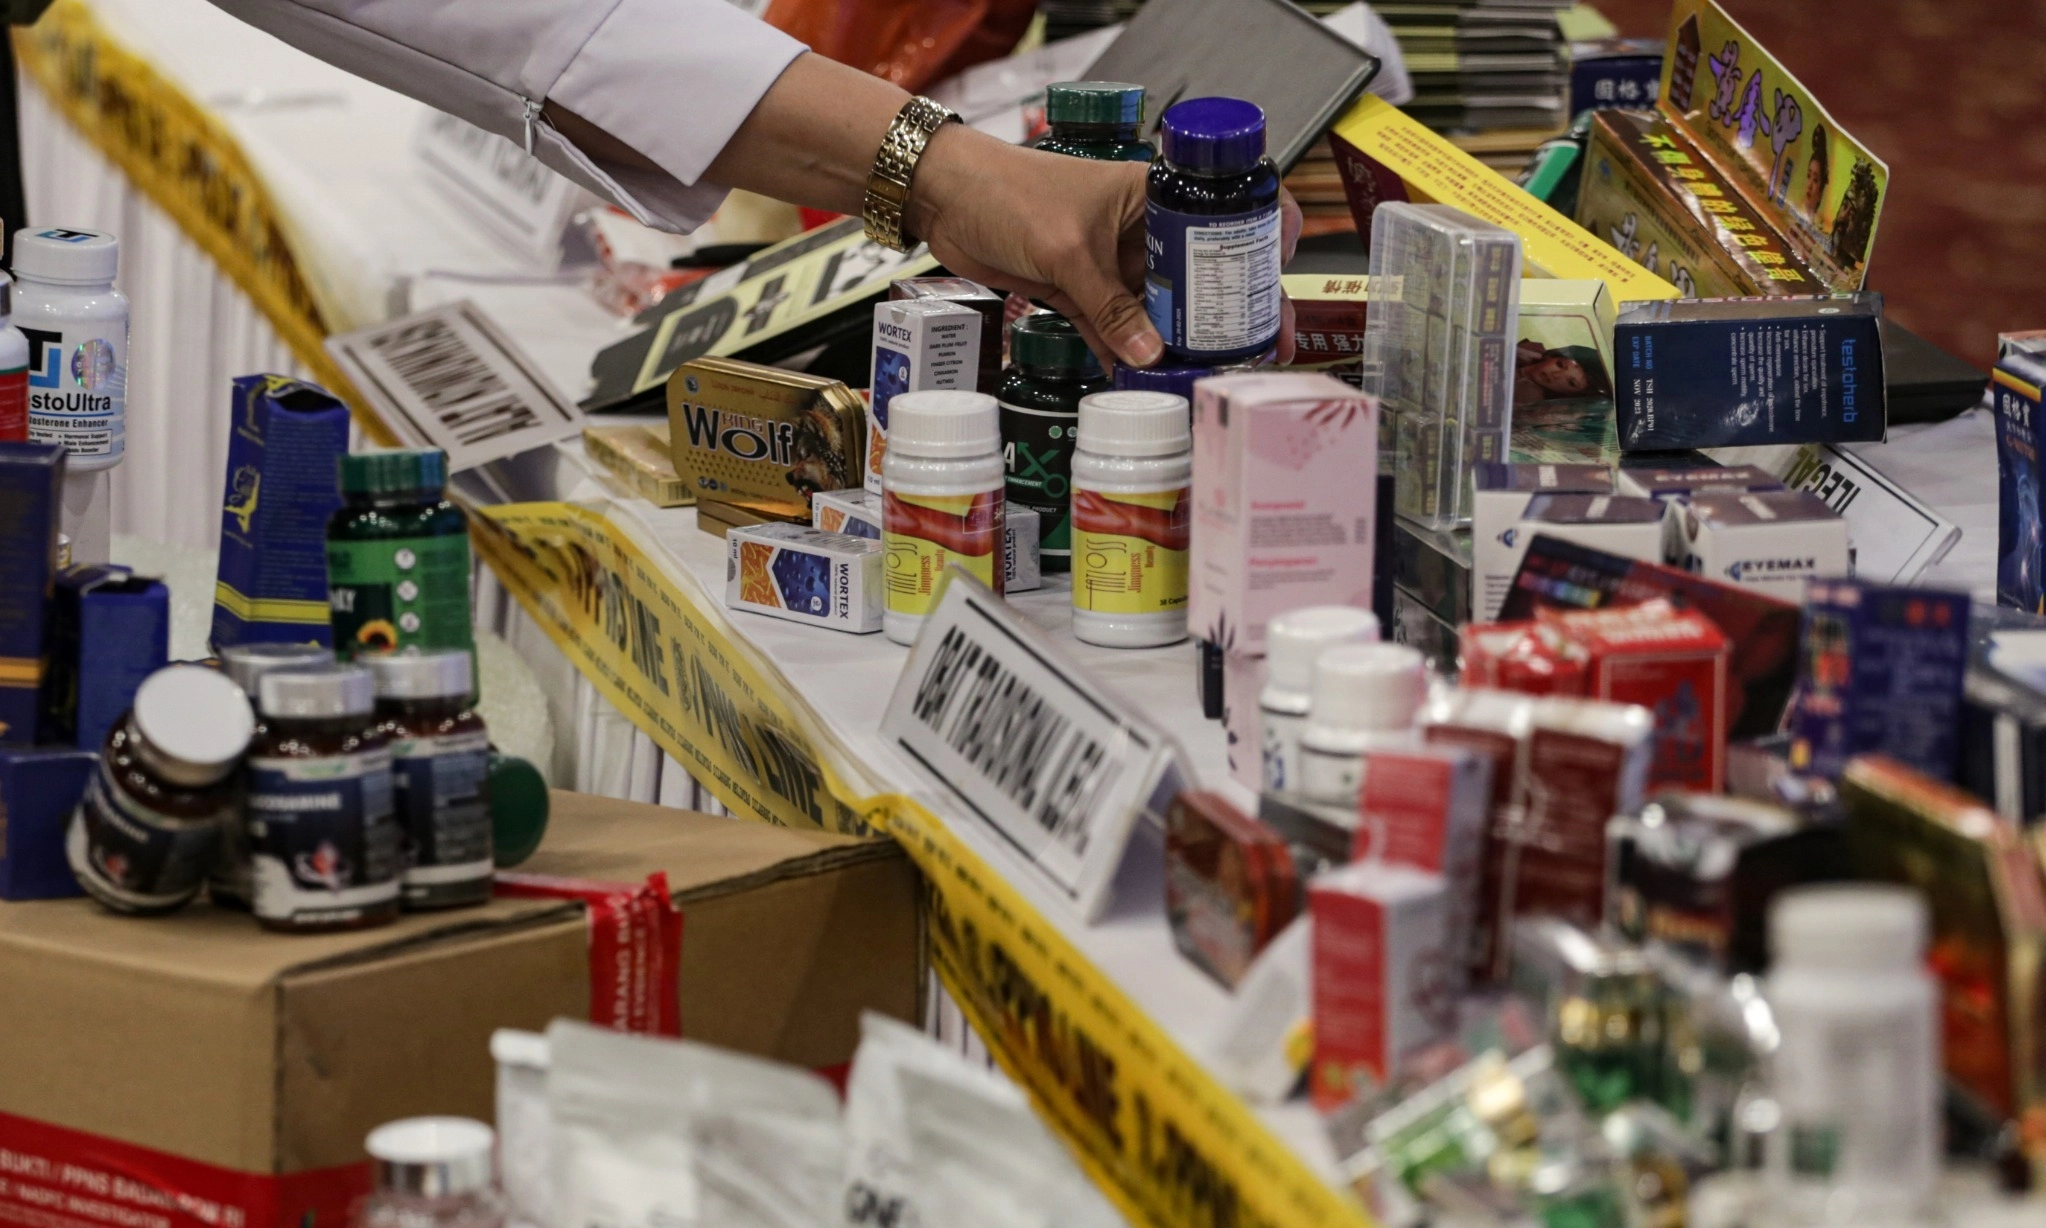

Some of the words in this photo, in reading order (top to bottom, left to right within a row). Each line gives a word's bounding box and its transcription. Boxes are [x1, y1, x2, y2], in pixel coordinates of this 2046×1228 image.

[1220, 239, 1255, 250] Supplement
[878, 321, 912, 343] WORTEX
[931, 324, 965, 333] INGREDIENT
[1842, 338, 1858, 423] testoherb
[29, 392, 112, 412] stoUltra
[72, 419, 109, 428] Enhancer
[722, 412, 763, 433] KING
[1783, 447, 1861, 516] ILEGAL
[1031, 505, 1058, 514] PRODUCT
[732, 538, 738, 548] 10
[1742, 556, 1815, 571] EYEMAX
[839, 563, 849, 620] WORTEX
